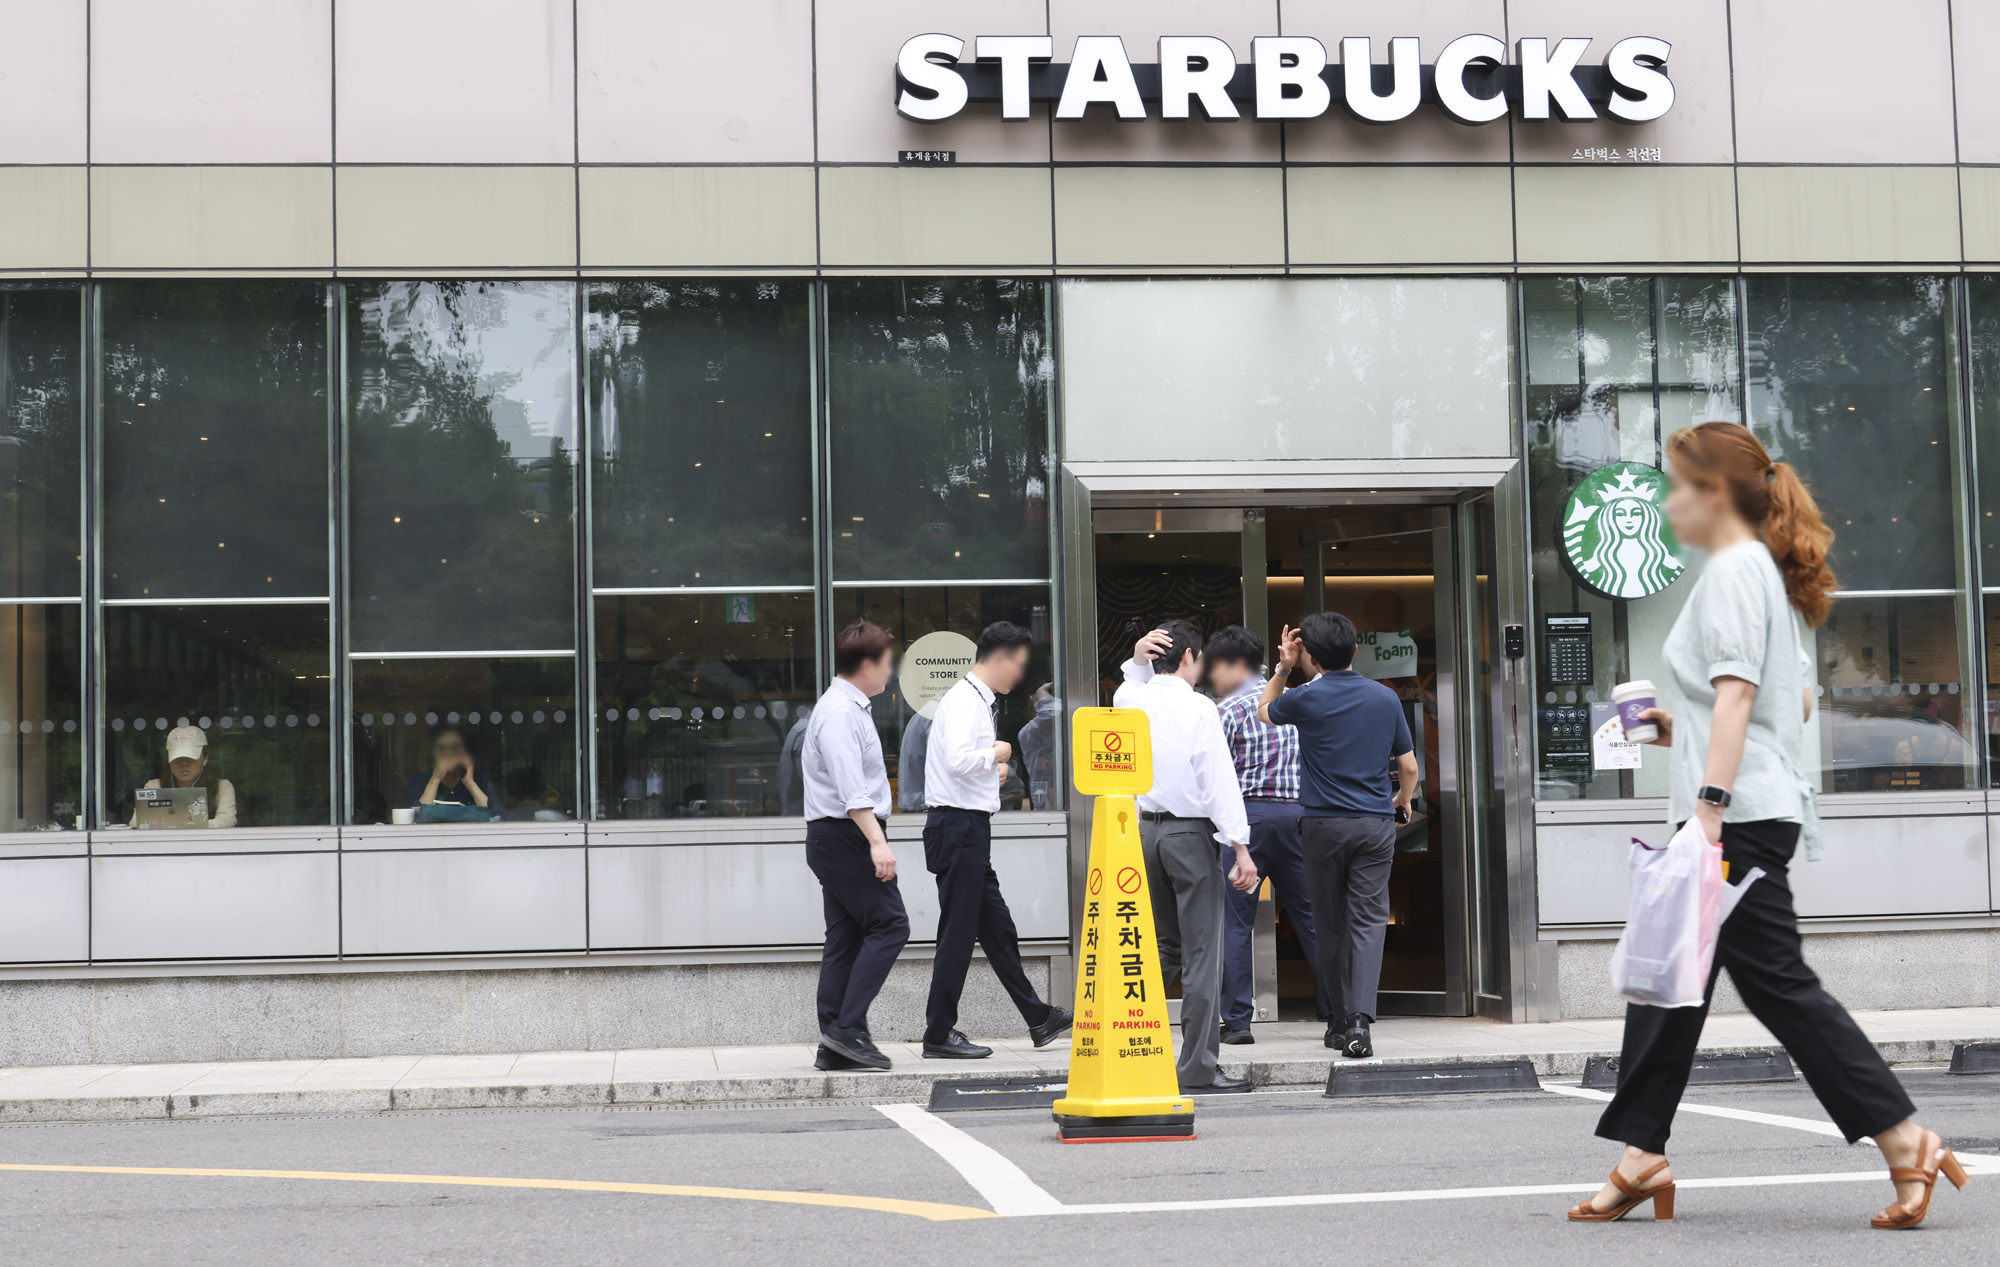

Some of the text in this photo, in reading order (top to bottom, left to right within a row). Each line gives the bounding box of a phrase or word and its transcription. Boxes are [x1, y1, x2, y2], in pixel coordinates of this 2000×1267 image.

[897, 34, 1675, 124] STARBUCKS
[905, 151, 950, 162] 휴게음식점
[1571, 147, 1661, 161] 스타벅스 적선점
[1357, 630, 1377, 645] old
[1375, 645, 1413, 661] Foam
[930, 671, 957, 679] STORE
[1095, 753, 1131, 763] 주차금지
[1084, 902, 1099, 1003] 주차금지
[1116, 901, 1146, 1002] 주차금지
[1085, 1010, 1093, 1018] NO
[1128, 1009, 1144, 1017] NO
[1076, 1021, 1100, 1030] PARKING
[1113, 1020, 1161, 1029] PARKING
[1082, 1037, 1094, 1046] 협조에
[1129, 1036, 1152, 1046] 협조에
[1076, 1048, 1099, 1057] 감사드립니다
[1119, 1047, 1164, 1058] 감사드립니다
